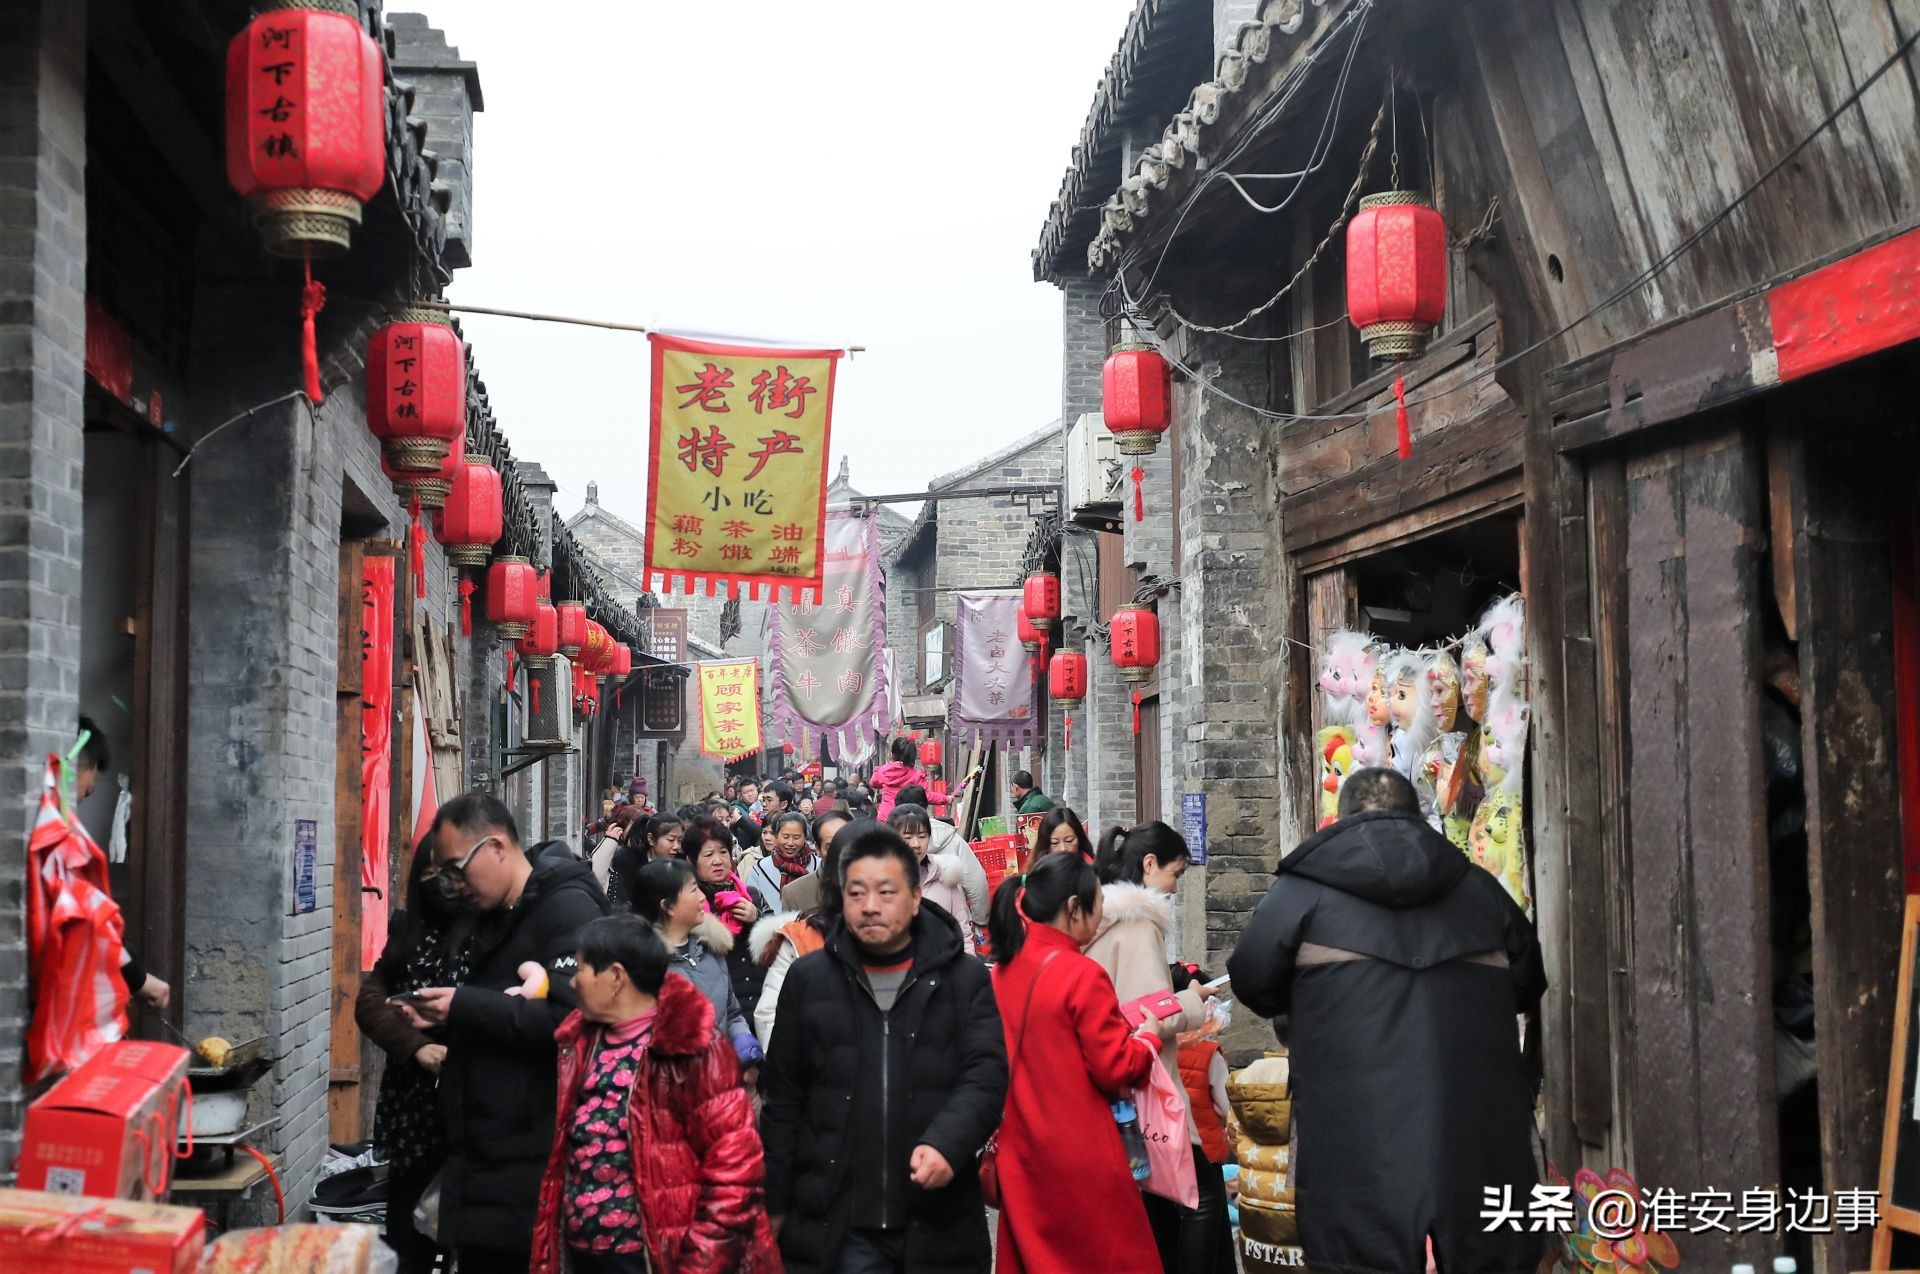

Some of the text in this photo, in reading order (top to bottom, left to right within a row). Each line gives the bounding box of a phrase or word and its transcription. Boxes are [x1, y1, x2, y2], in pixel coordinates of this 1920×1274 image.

[260, 27, 298, 158] 河下古镇
[393, 335, 419, 419] 河下古镇
[676, 363, 817, 418] 老街
[677, 425, 804, 481] 特产
[702, 486, 774, 515] 小吃
[705, 665, 752, 680] 百年老店
[793, 669, 863, 700] 牛肉
